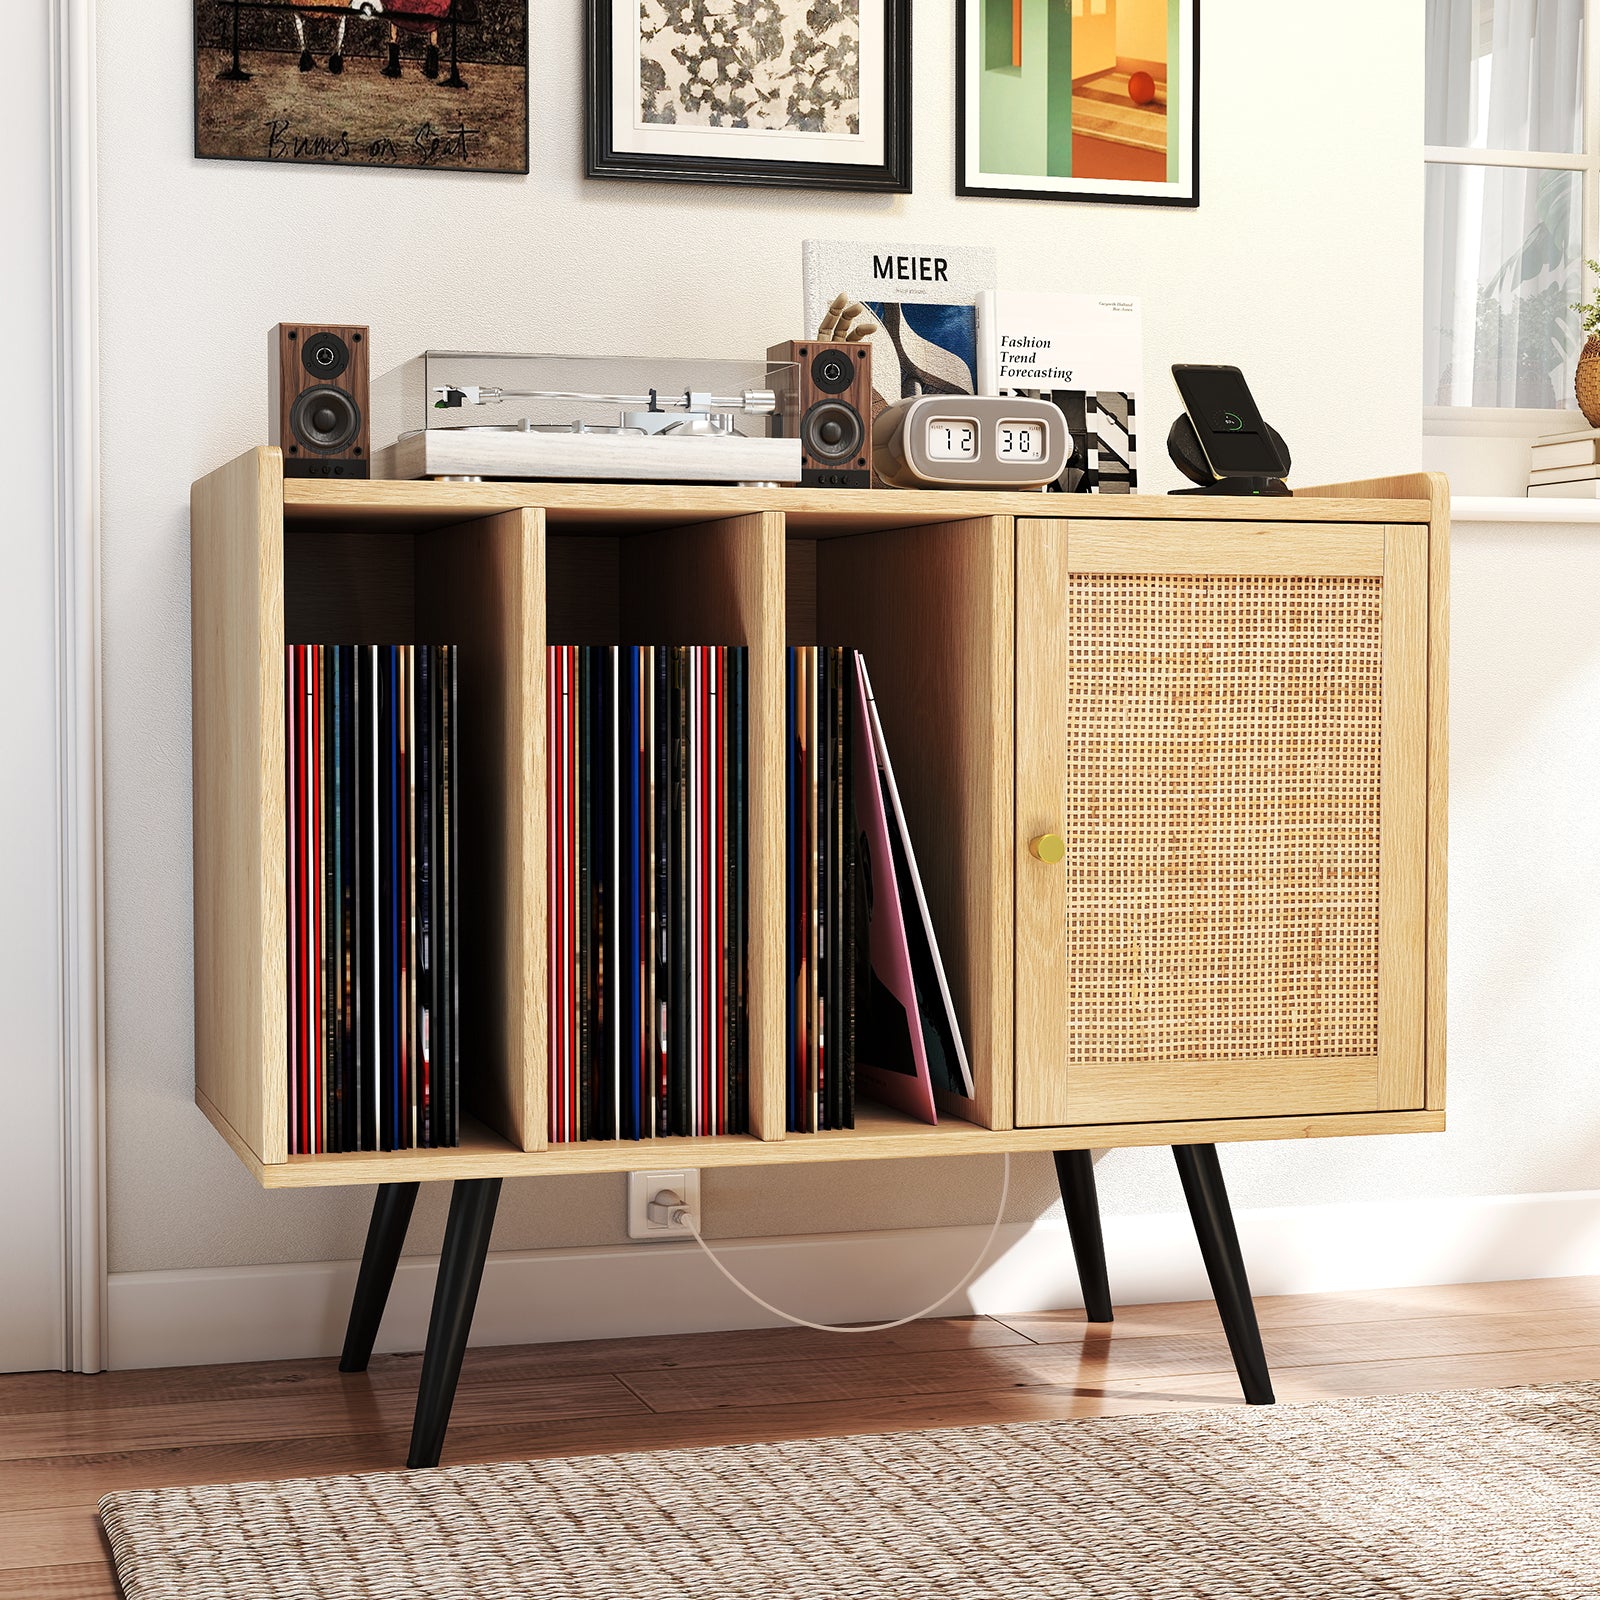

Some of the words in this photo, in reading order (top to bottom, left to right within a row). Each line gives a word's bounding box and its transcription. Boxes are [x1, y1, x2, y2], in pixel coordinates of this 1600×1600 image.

[264, 120, 350, 158] Bums
[368, 138, 397, 158] on
[415, 121, 480, 164] Seat
[873, 255, 948, 282] MEIER
[1000, 335, 1051, 349] Fashion
[1000, 351, 1036, 364] Trend
[999, 365, 1073, 383] Forecasting
[945, 428, 972, 452] 12
[1002, 430, 1030, 453] 30
